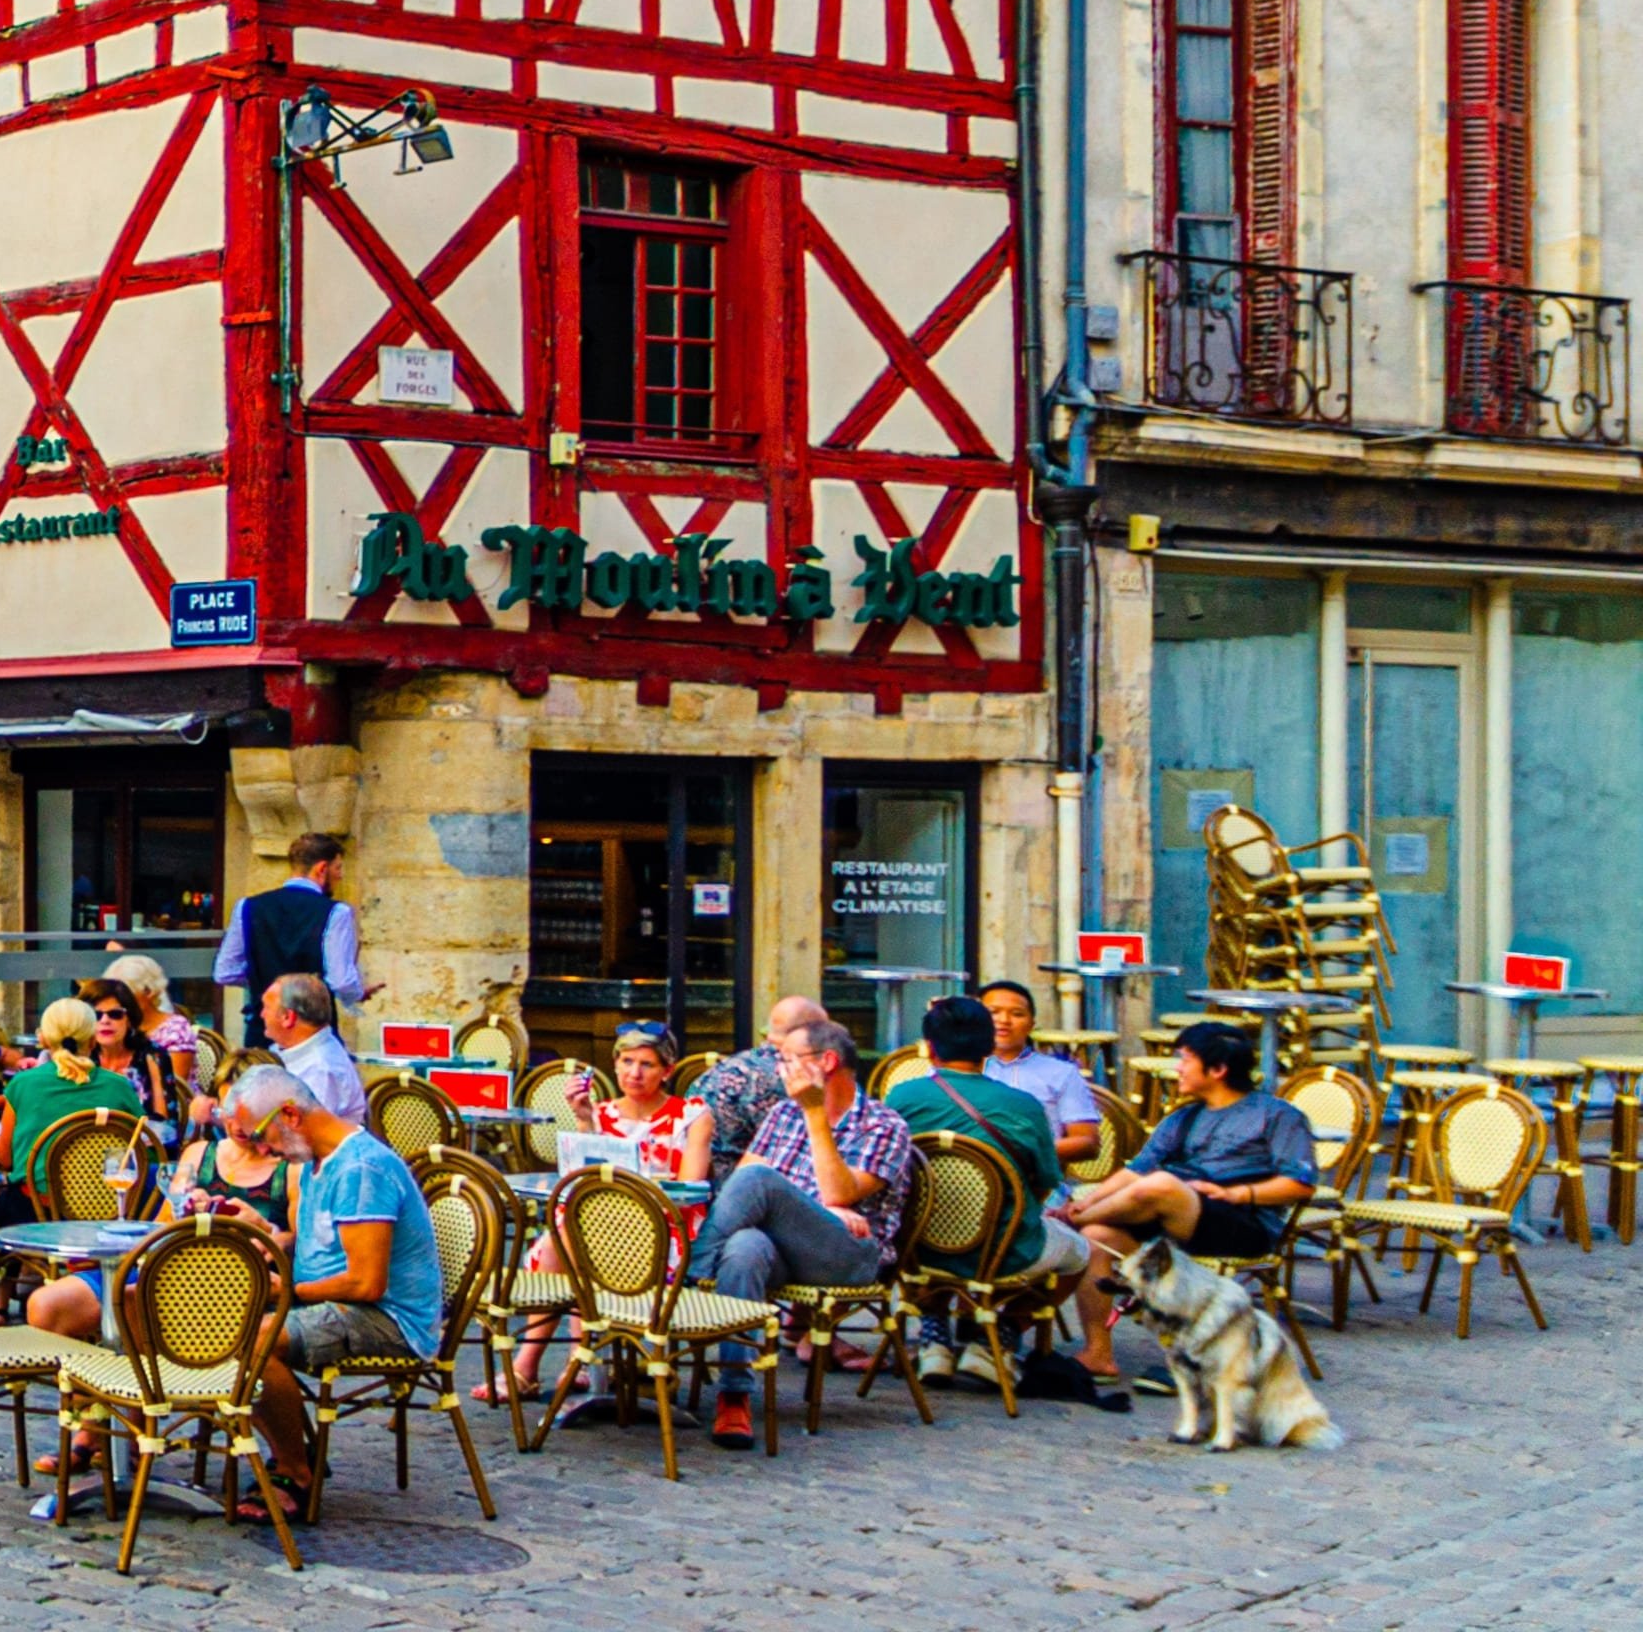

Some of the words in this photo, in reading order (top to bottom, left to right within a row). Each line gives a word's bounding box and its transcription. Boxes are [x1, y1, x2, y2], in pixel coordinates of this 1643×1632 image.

[406, 354, 427, 366] RUE
[396, 382, 438, 396] FORGES
[17, 435, 69, 466] Bar
[350, 512, 475, 602] Au
[481, 524, 778, 617] Moulin
[787, 545, 835, 619] à
[851, 534, 1025, 628] Vent
[189, 591, 235, 610] PLACE
[218, 615, 248, 633] RUDE
[831, 861, 948, 876] RESTAURANT
[843, 880, 857, 894] A
[861, 880, 936, 895] L'ETAGE
[831, 898, 947, 914] CLIMATISE
